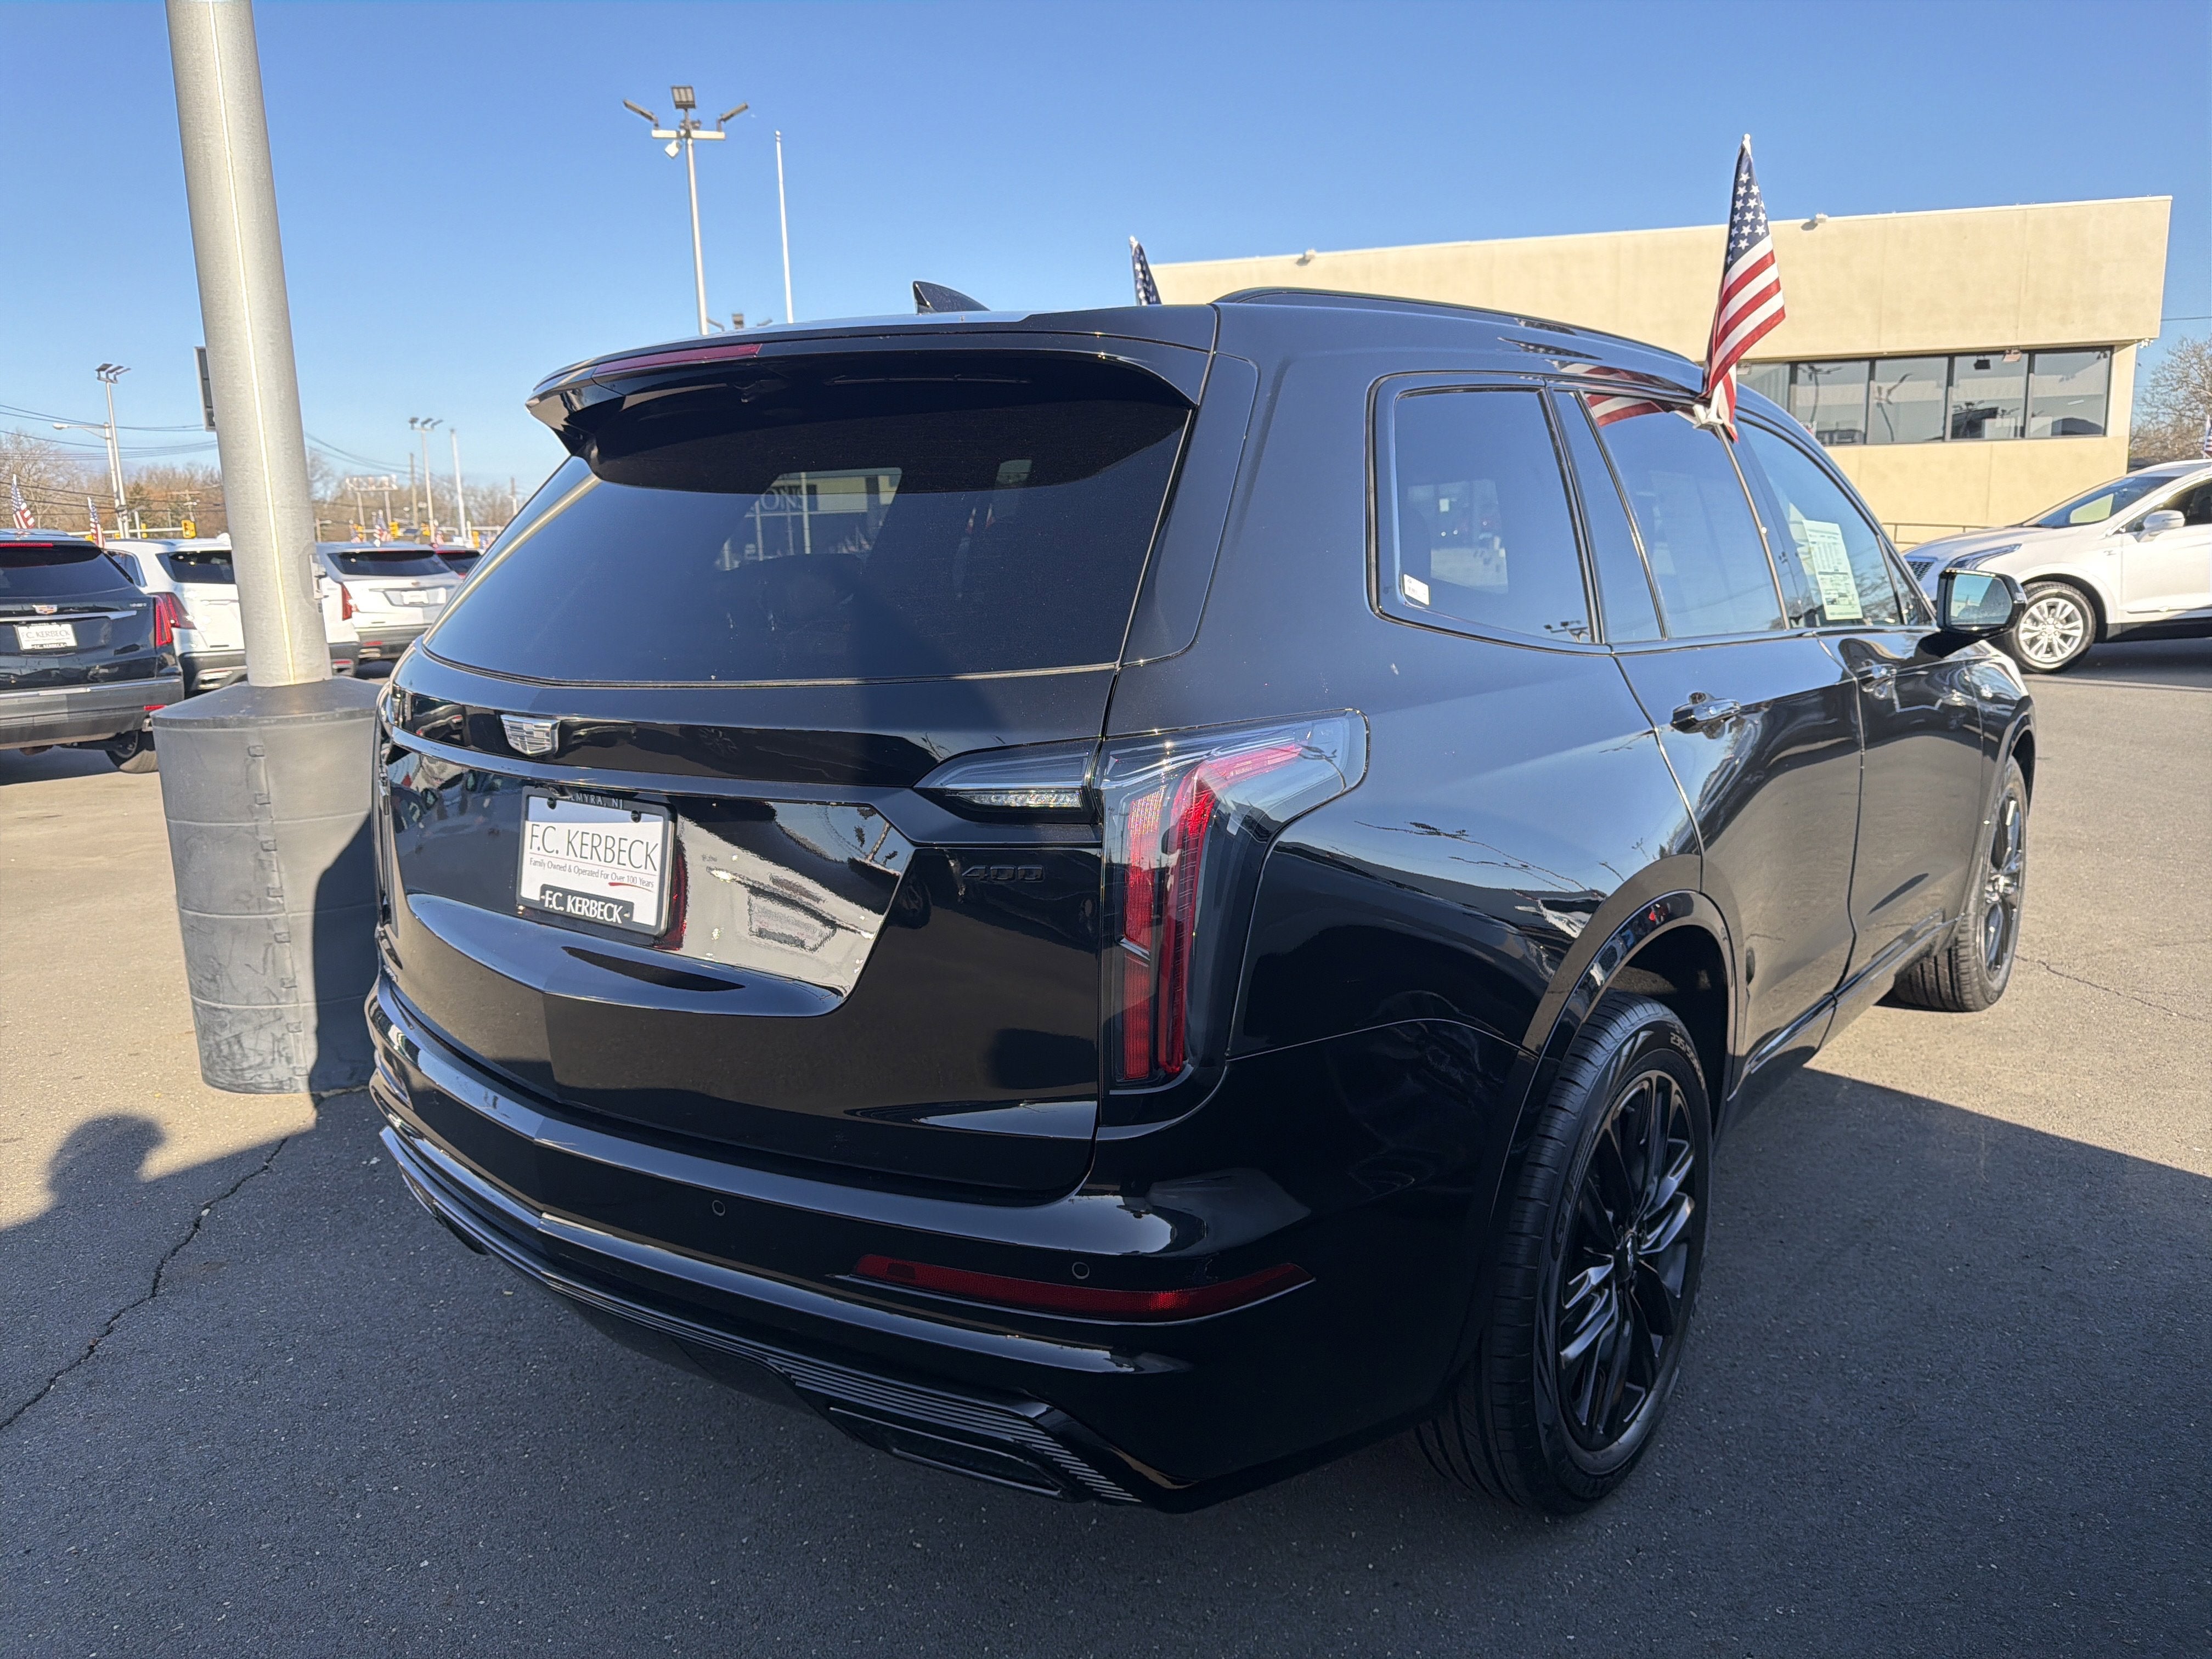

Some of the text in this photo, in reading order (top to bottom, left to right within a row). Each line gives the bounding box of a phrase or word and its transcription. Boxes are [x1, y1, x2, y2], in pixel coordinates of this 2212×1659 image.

[612, 798, 623, 809] NJ
[529, 823, 658, 872] F.C. KERBECK
[529, 857, 546, 870] Family
[548, 861, 567, 872] Owned
[573, 866, 600, 878] Operated
[600, 871, 610, 879] For
[611, 872, 624, 882] Over
[627, 875, 637, 884] 100
[639, 878, 654, 888] Years
[962, 864, 1043, 882] 400
[544, 890, 623, 924] F.C. KERBECK
